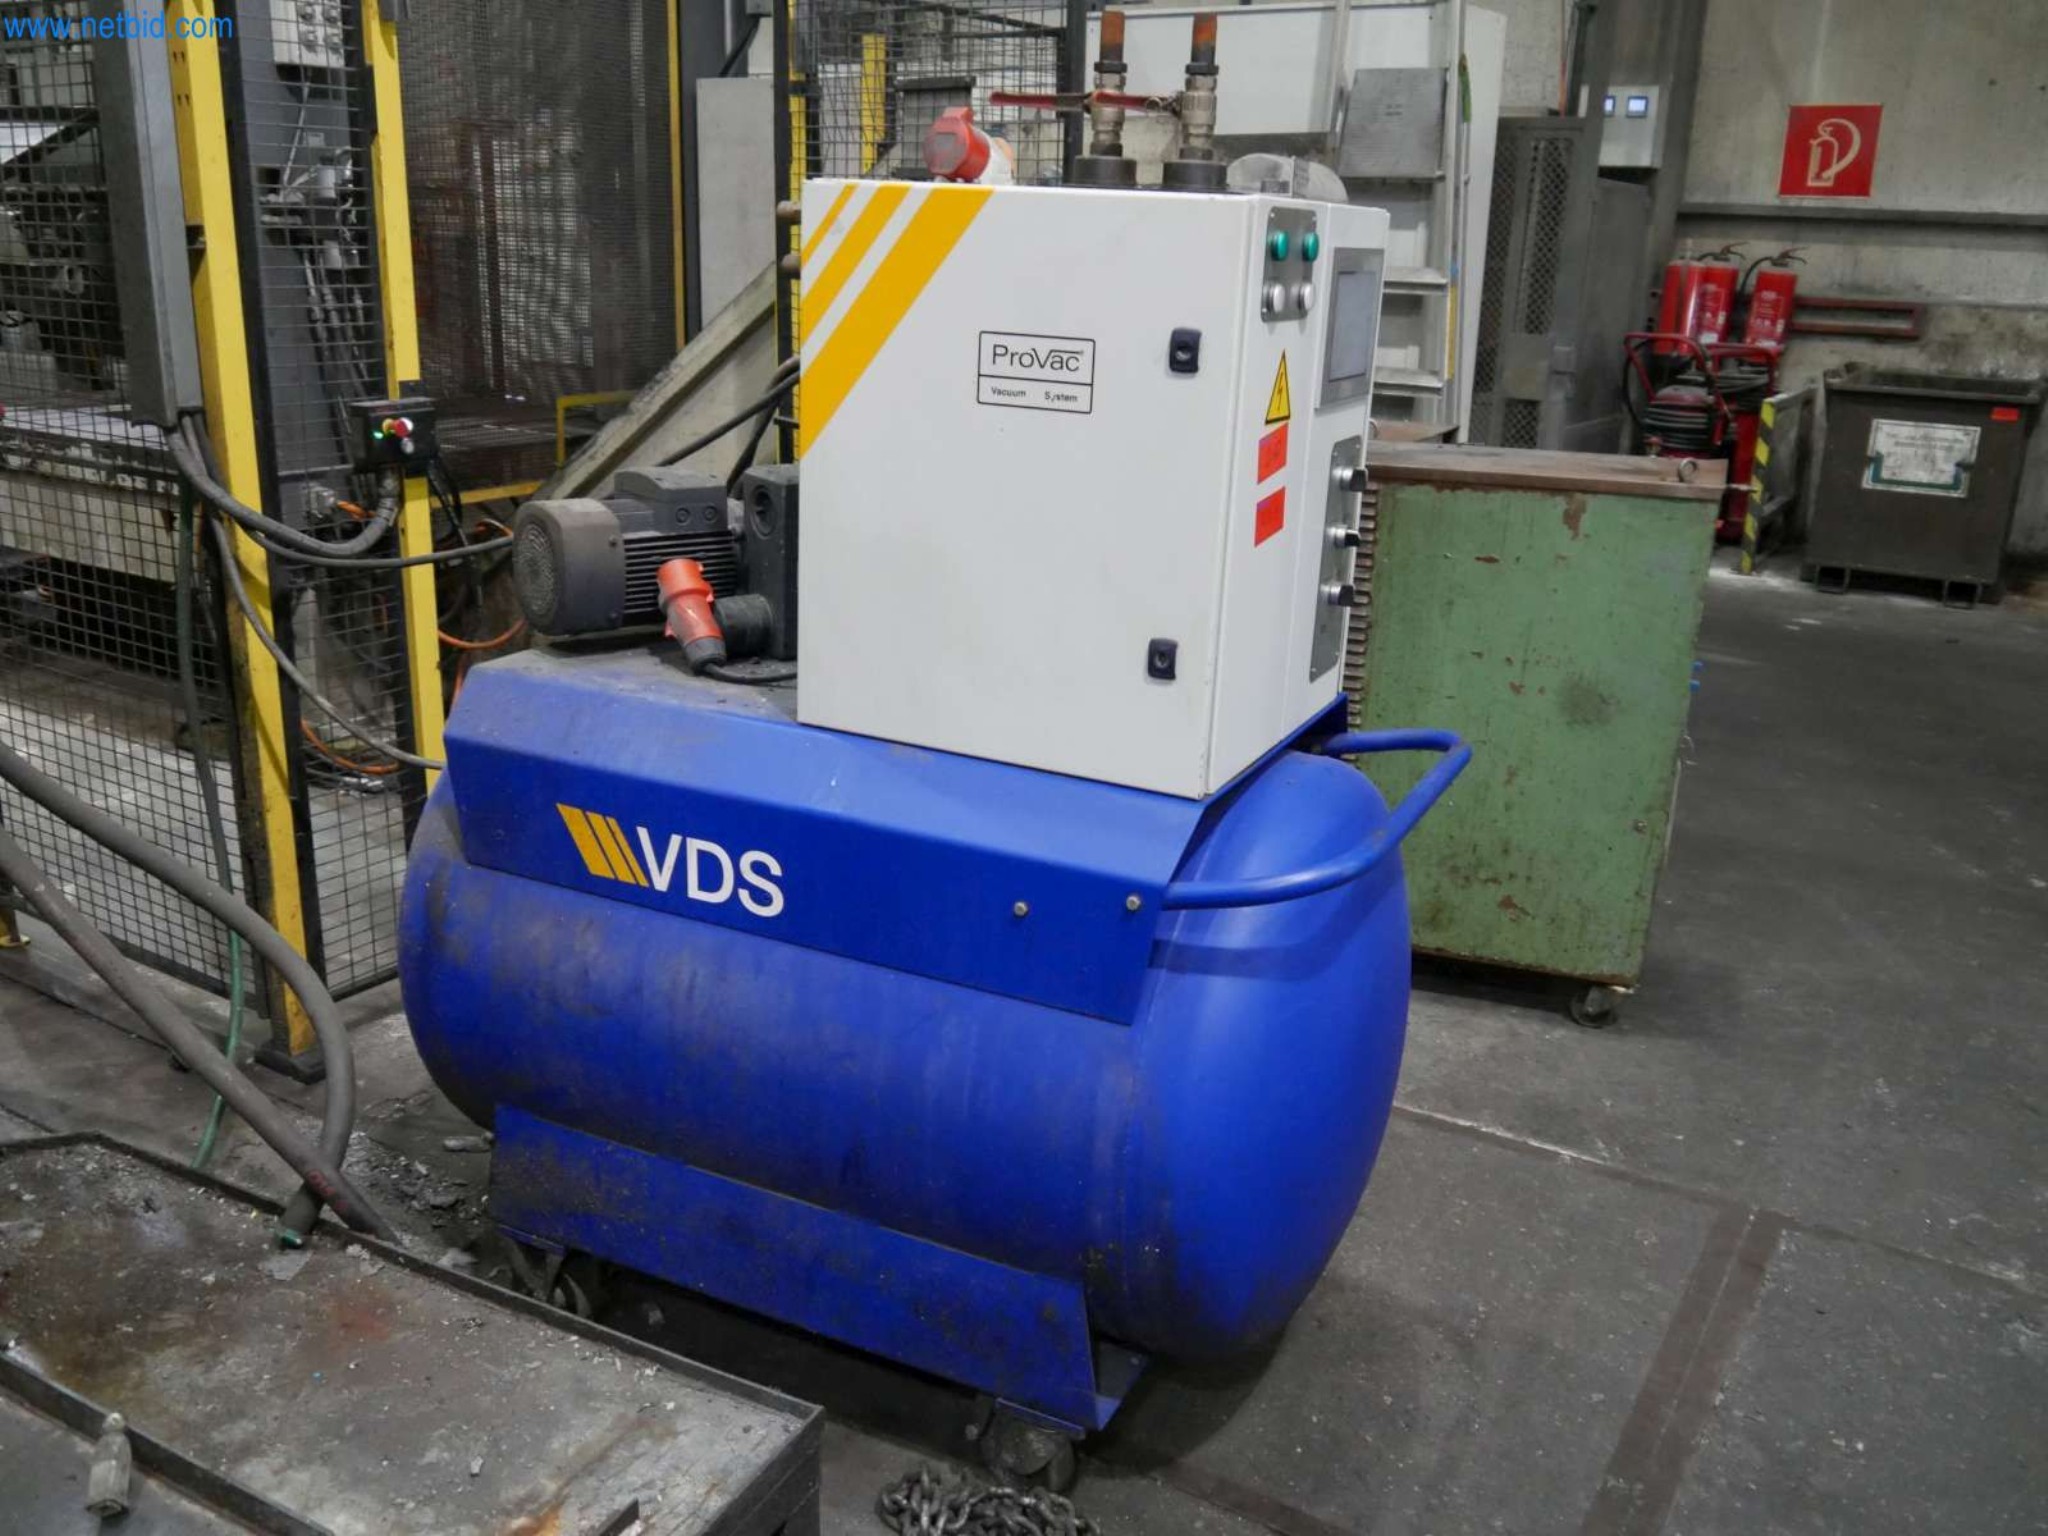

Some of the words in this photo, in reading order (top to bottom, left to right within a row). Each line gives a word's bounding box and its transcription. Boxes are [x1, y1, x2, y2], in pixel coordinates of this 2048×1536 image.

[992, 343, 1082, 372] ProVac
[991, 386, 1026, 398] Vacuum
[636, 826, 784, 917] VDS
